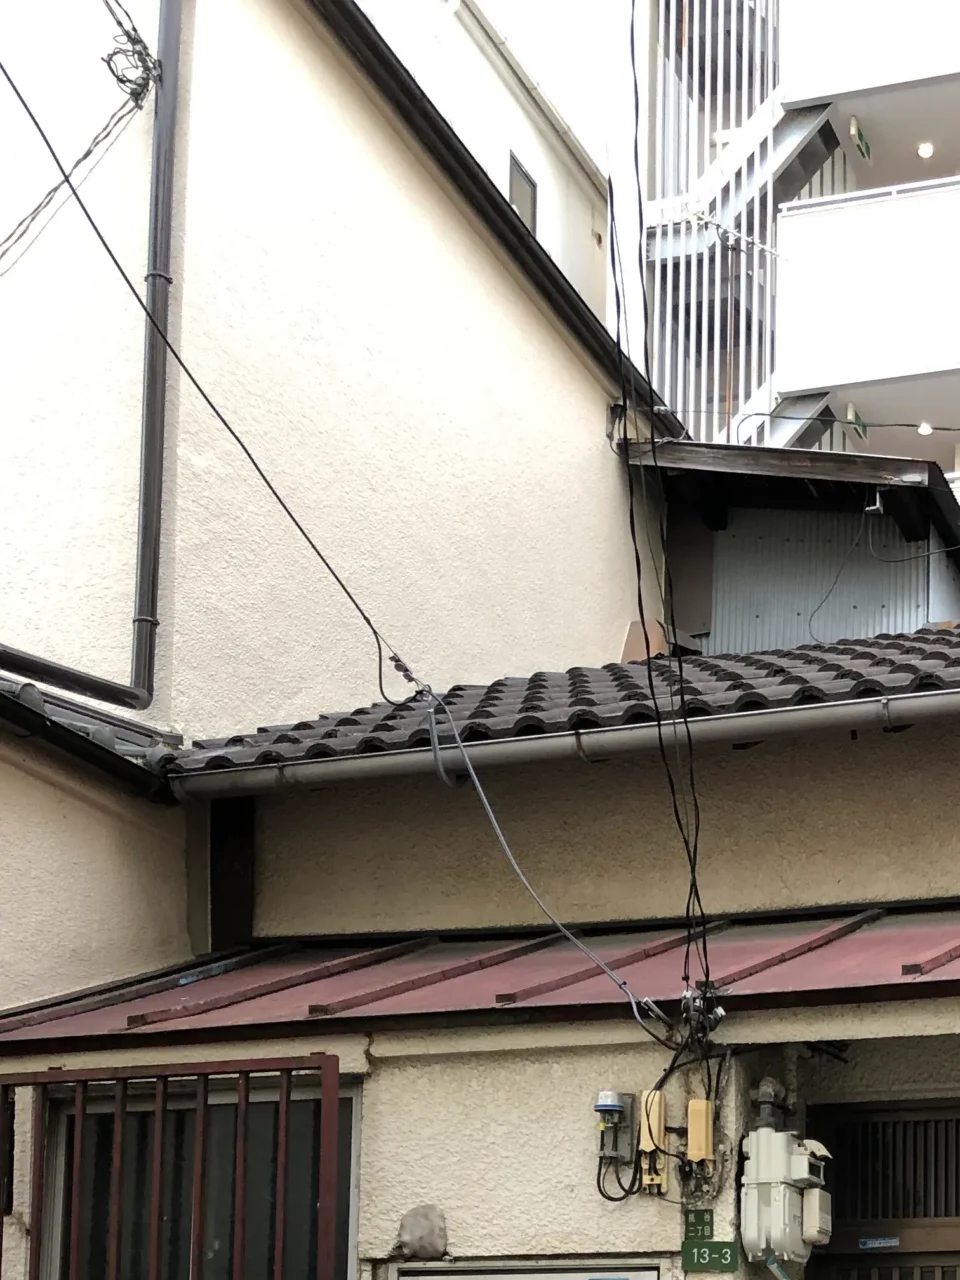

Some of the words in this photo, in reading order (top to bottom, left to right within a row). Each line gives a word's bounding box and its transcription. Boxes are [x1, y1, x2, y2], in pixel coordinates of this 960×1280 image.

[688, 1226, 711, 1236] 二丁目
[692, 1248, 731, 1264] 13-3
